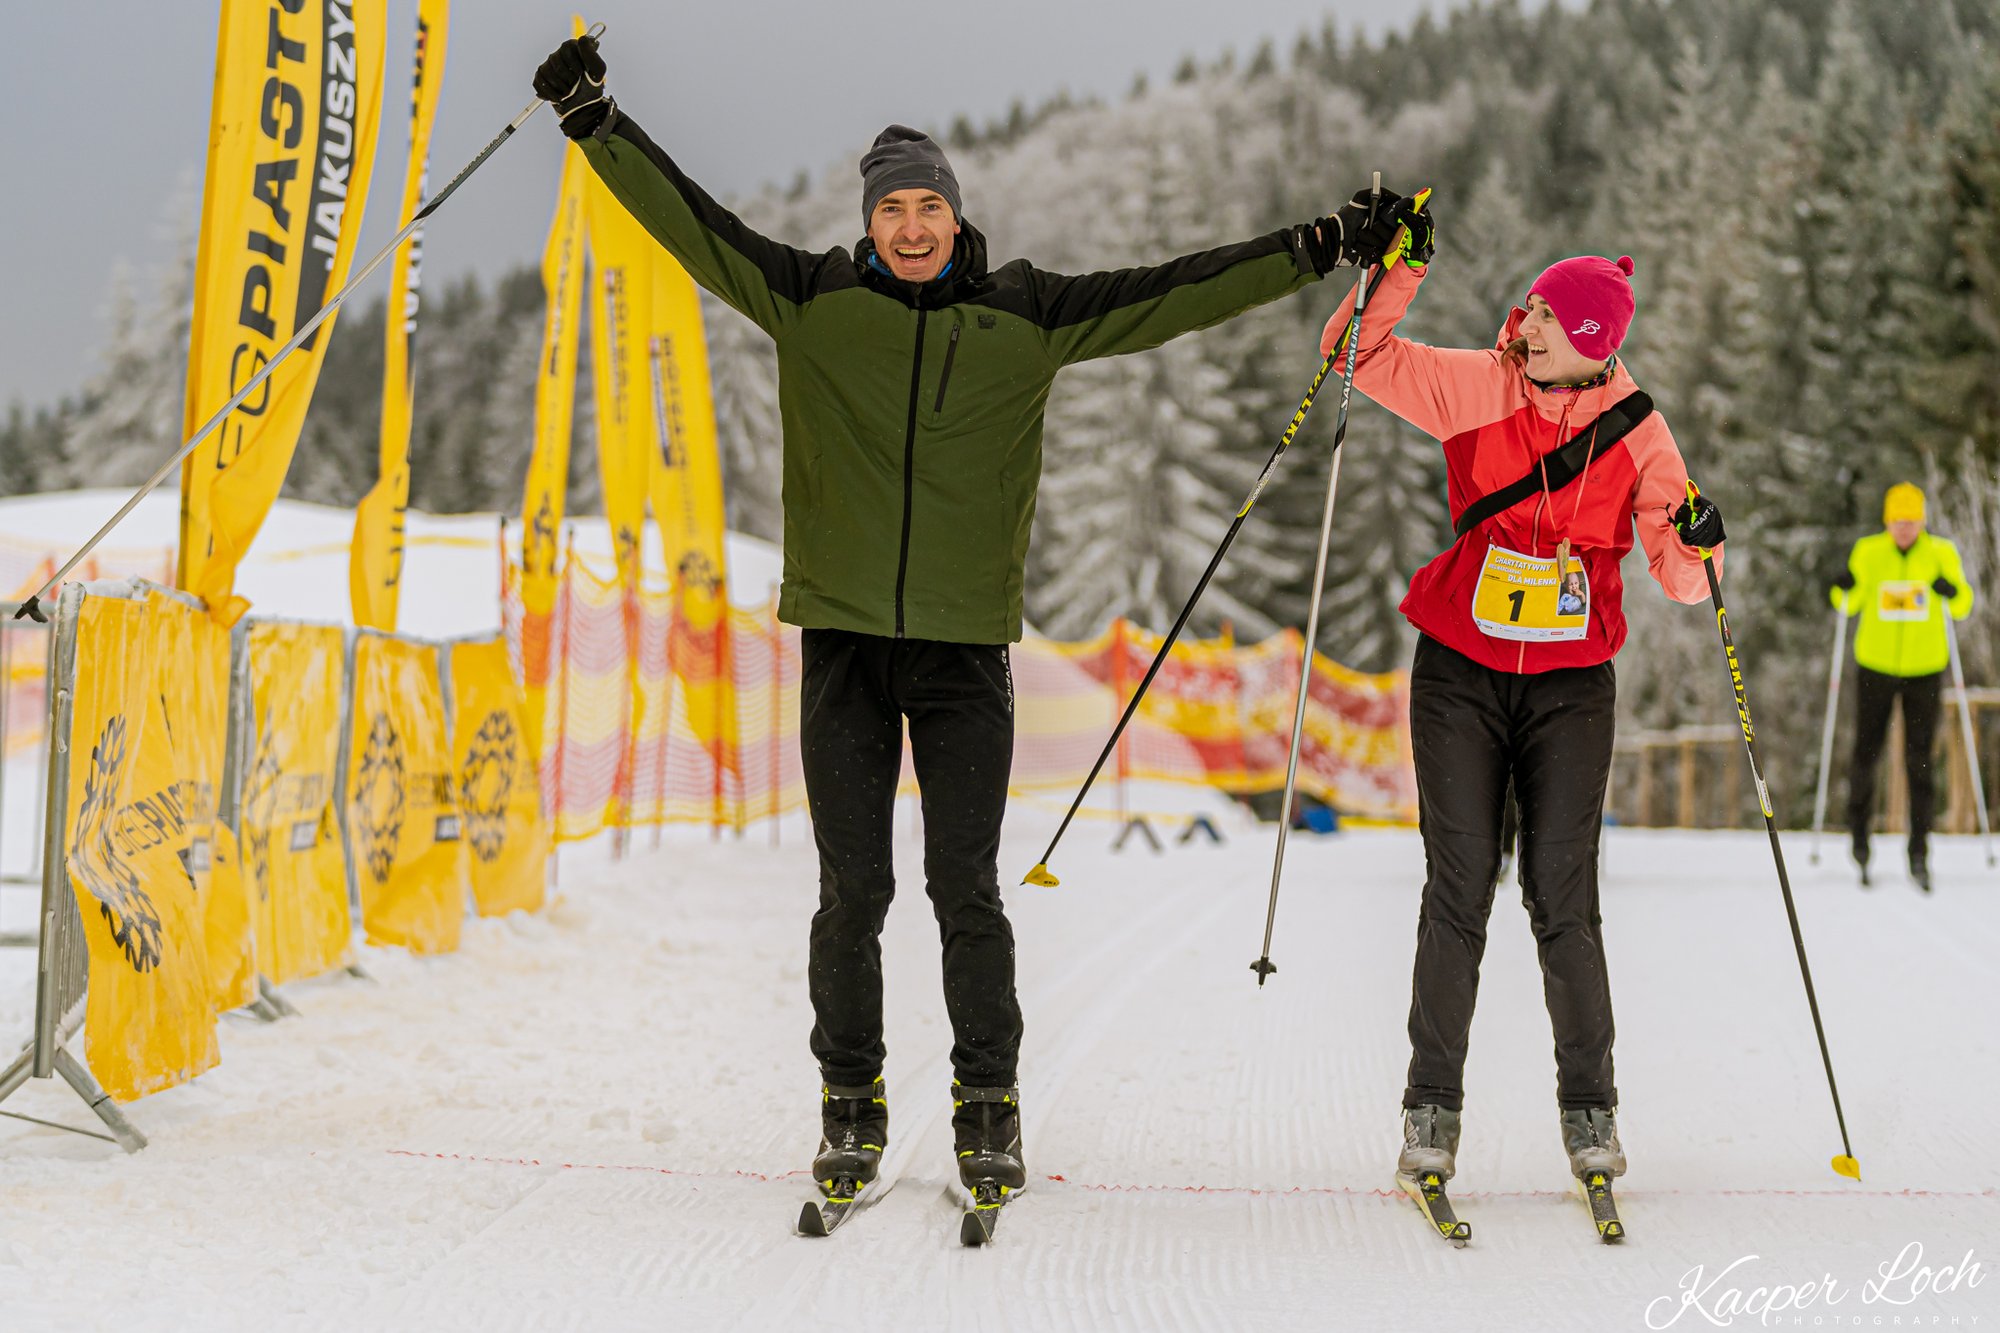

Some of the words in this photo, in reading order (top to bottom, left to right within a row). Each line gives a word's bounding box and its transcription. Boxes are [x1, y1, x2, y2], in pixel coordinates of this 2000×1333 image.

[311, 0, 358, 272] JAKUSZY
[1340, 321, 1361, 411] SALOMON
[1283, 398, 1313, 446] LEKI
[1689, 508, 1711, 530] CRAFT
[1507, 574, 1523, 584] DLA
[1524, 577, 1557, 586] MILENKI
[1508, 589, 1526, 623] 1
[1725, 645, 1746, 692] LEKI
